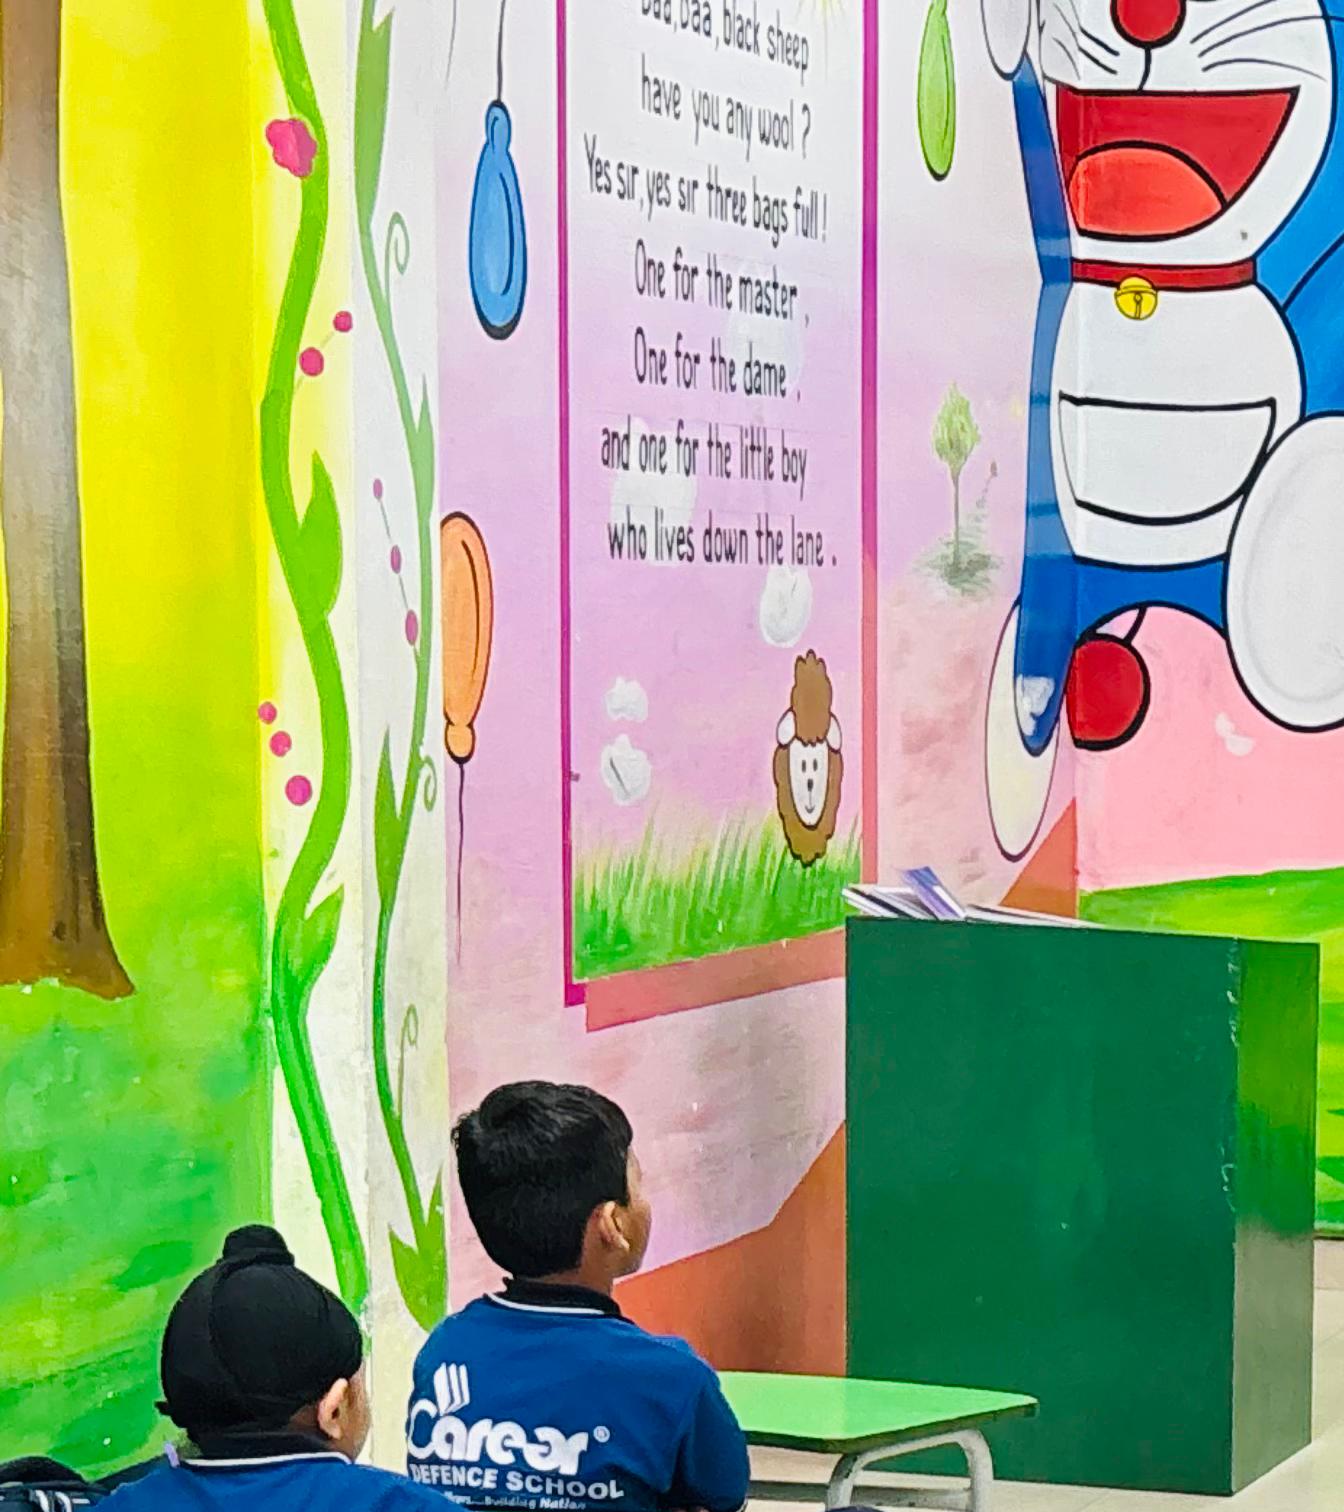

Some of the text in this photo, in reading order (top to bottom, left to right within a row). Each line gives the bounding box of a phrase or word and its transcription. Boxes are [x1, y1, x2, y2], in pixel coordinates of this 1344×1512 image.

[723, 0, 760, 56] black
[766, 9, 809, 86] sheep
[641, 52, 681, 120] have
[692, 88, 719, 146] you
[726, 97, 752, 162] any
[584, 132, 611, 194] Yes
[678, 176, 698, 214] sir
[706, 164, 747, 226] three
[752, 175, 788, 248] bags
[634, 238, 666, 298] One
[673, 246, 698, 304] for
[706, 252, 733, 310] the
[634, 326, 667, 385] One
[674, 331, 701, 390] for
[709, 337, 737, 394] the
[600, 414, 807, 502] and one for the little boy
[607, 504, 647, 561] who
[654, 508, 695, 562] lives
[702, 509, 748, 563] down
[755, 512, 784, 566] the
[409, 1463, 498, 1490] DEFENCE
[505, 1470, 624, 1500] SCHOOL
